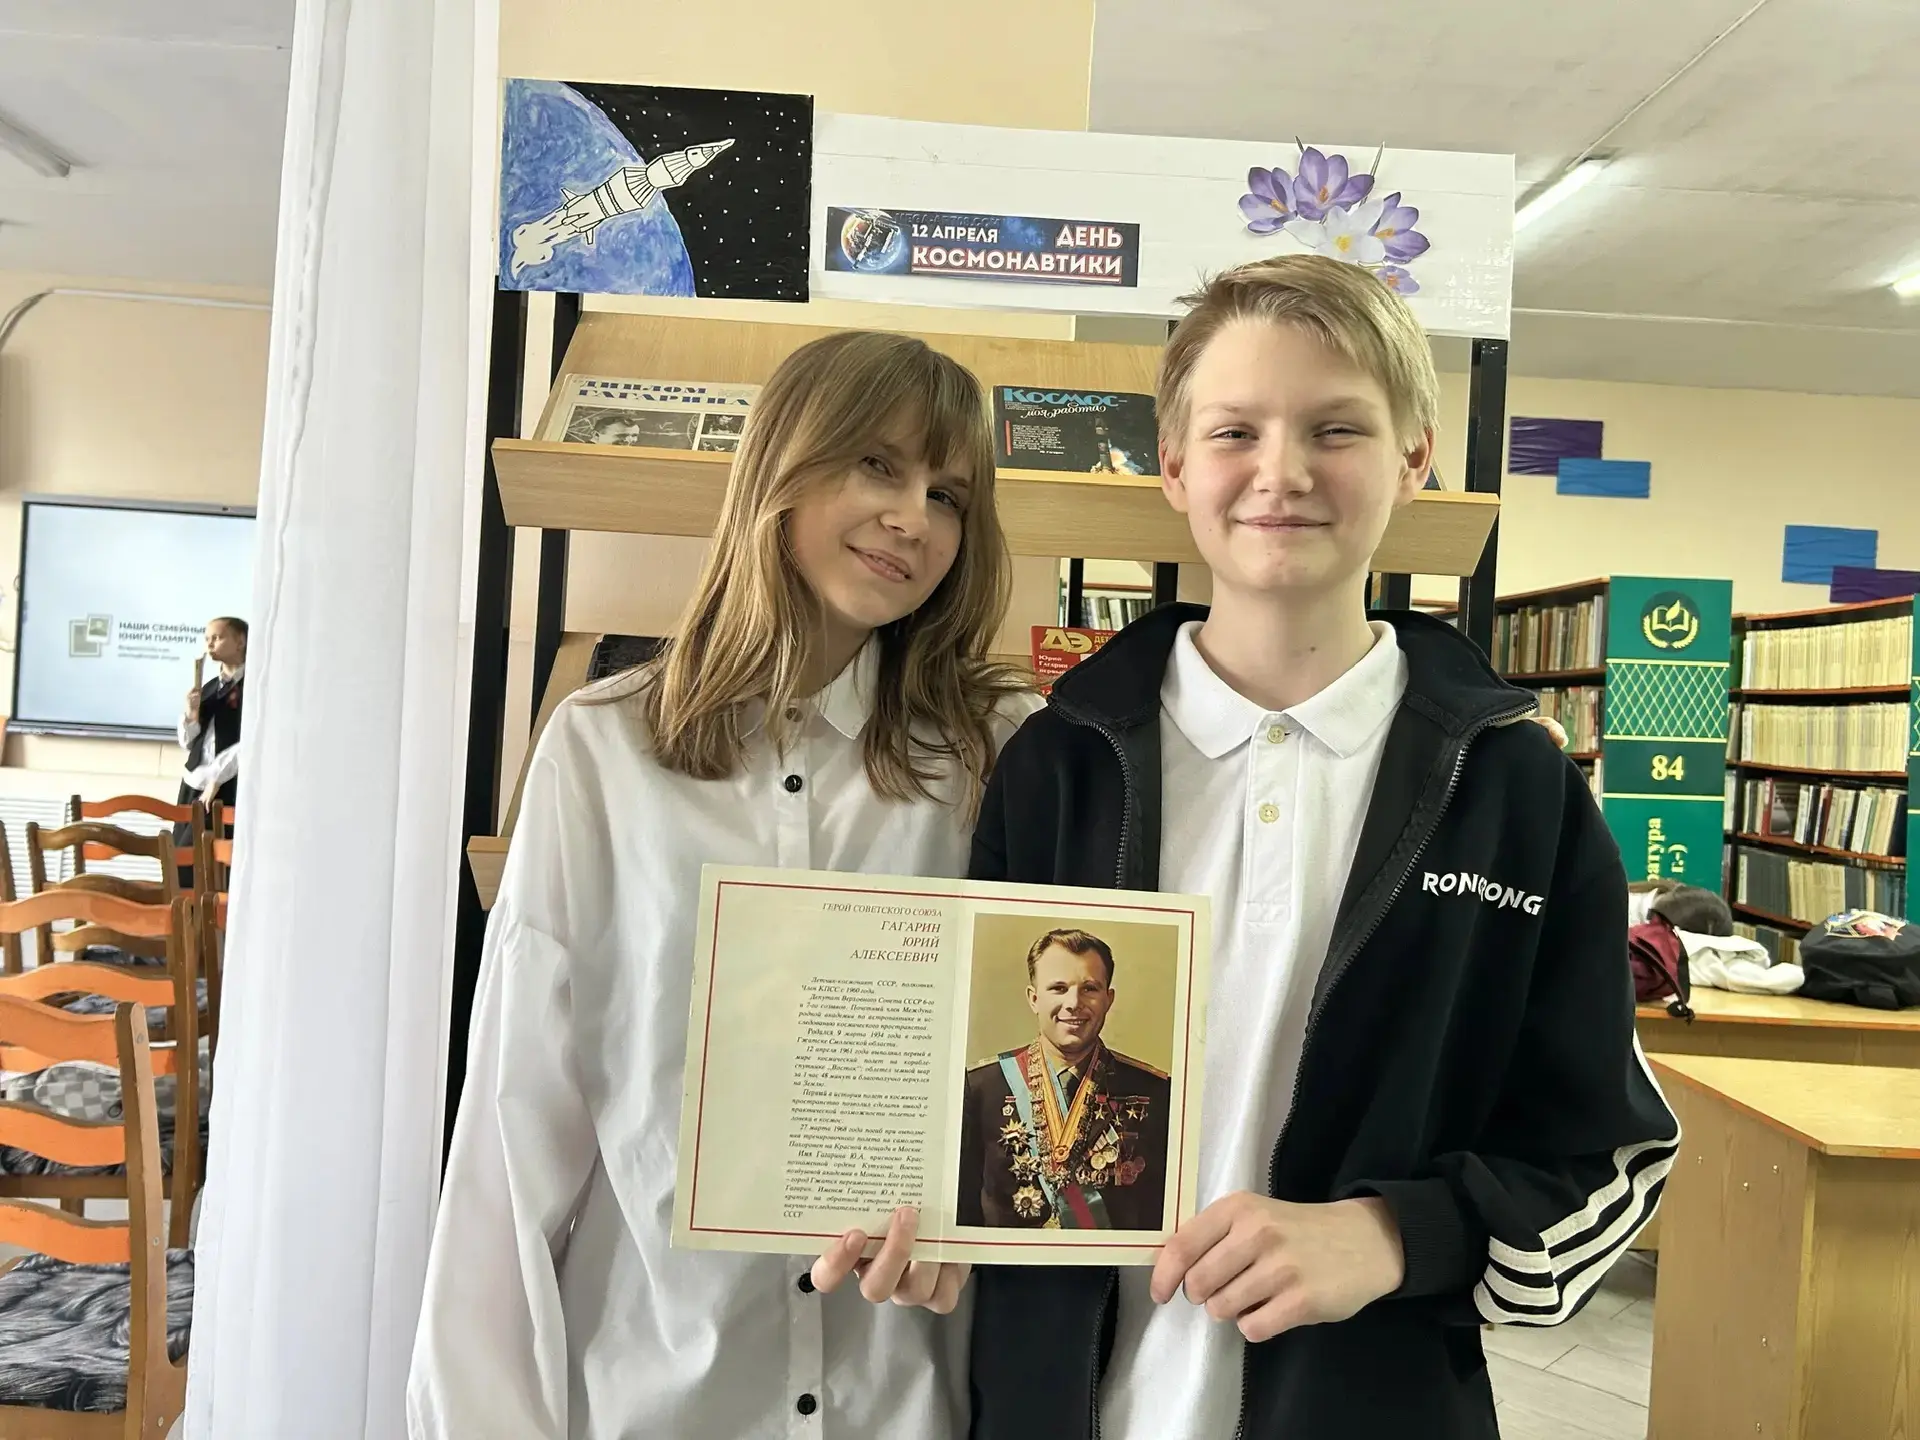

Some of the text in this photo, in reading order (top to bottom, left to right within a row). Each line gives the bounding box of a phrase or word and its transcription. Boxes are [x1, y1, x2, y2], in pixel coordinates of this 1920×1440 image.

[911, 224, 998, 243] 12 АПРЕЛЯ
[1055, 223, 1123, 249] ДЕНЬ
[912, 246, 1122, 277] КОСМОНАВТИКИ
[580, 380, 707, 395] ДИПЛОМ
[578, 389, 751, 406] ГАГАРИНА
[119, 621, 150, 631] НАШИ
[119, 632, 197, 644] КНИГИ ПАМЯТИ
[1040, 628, 1093, 654] ДЭ
[1651, 754, 1684, 781] 84
[822, 902, 943, 917] ГЕРОЙ СОВЕТСКОГО СОЮЗА
[880, 920, 942, 933] ГАГАРИН
[902, 935, 940, 948] ЮРИЙ
[850, 949, 940, 963] АЛЕКСЕЕВИЧ
[818, 984, 838, 992] КПСС
